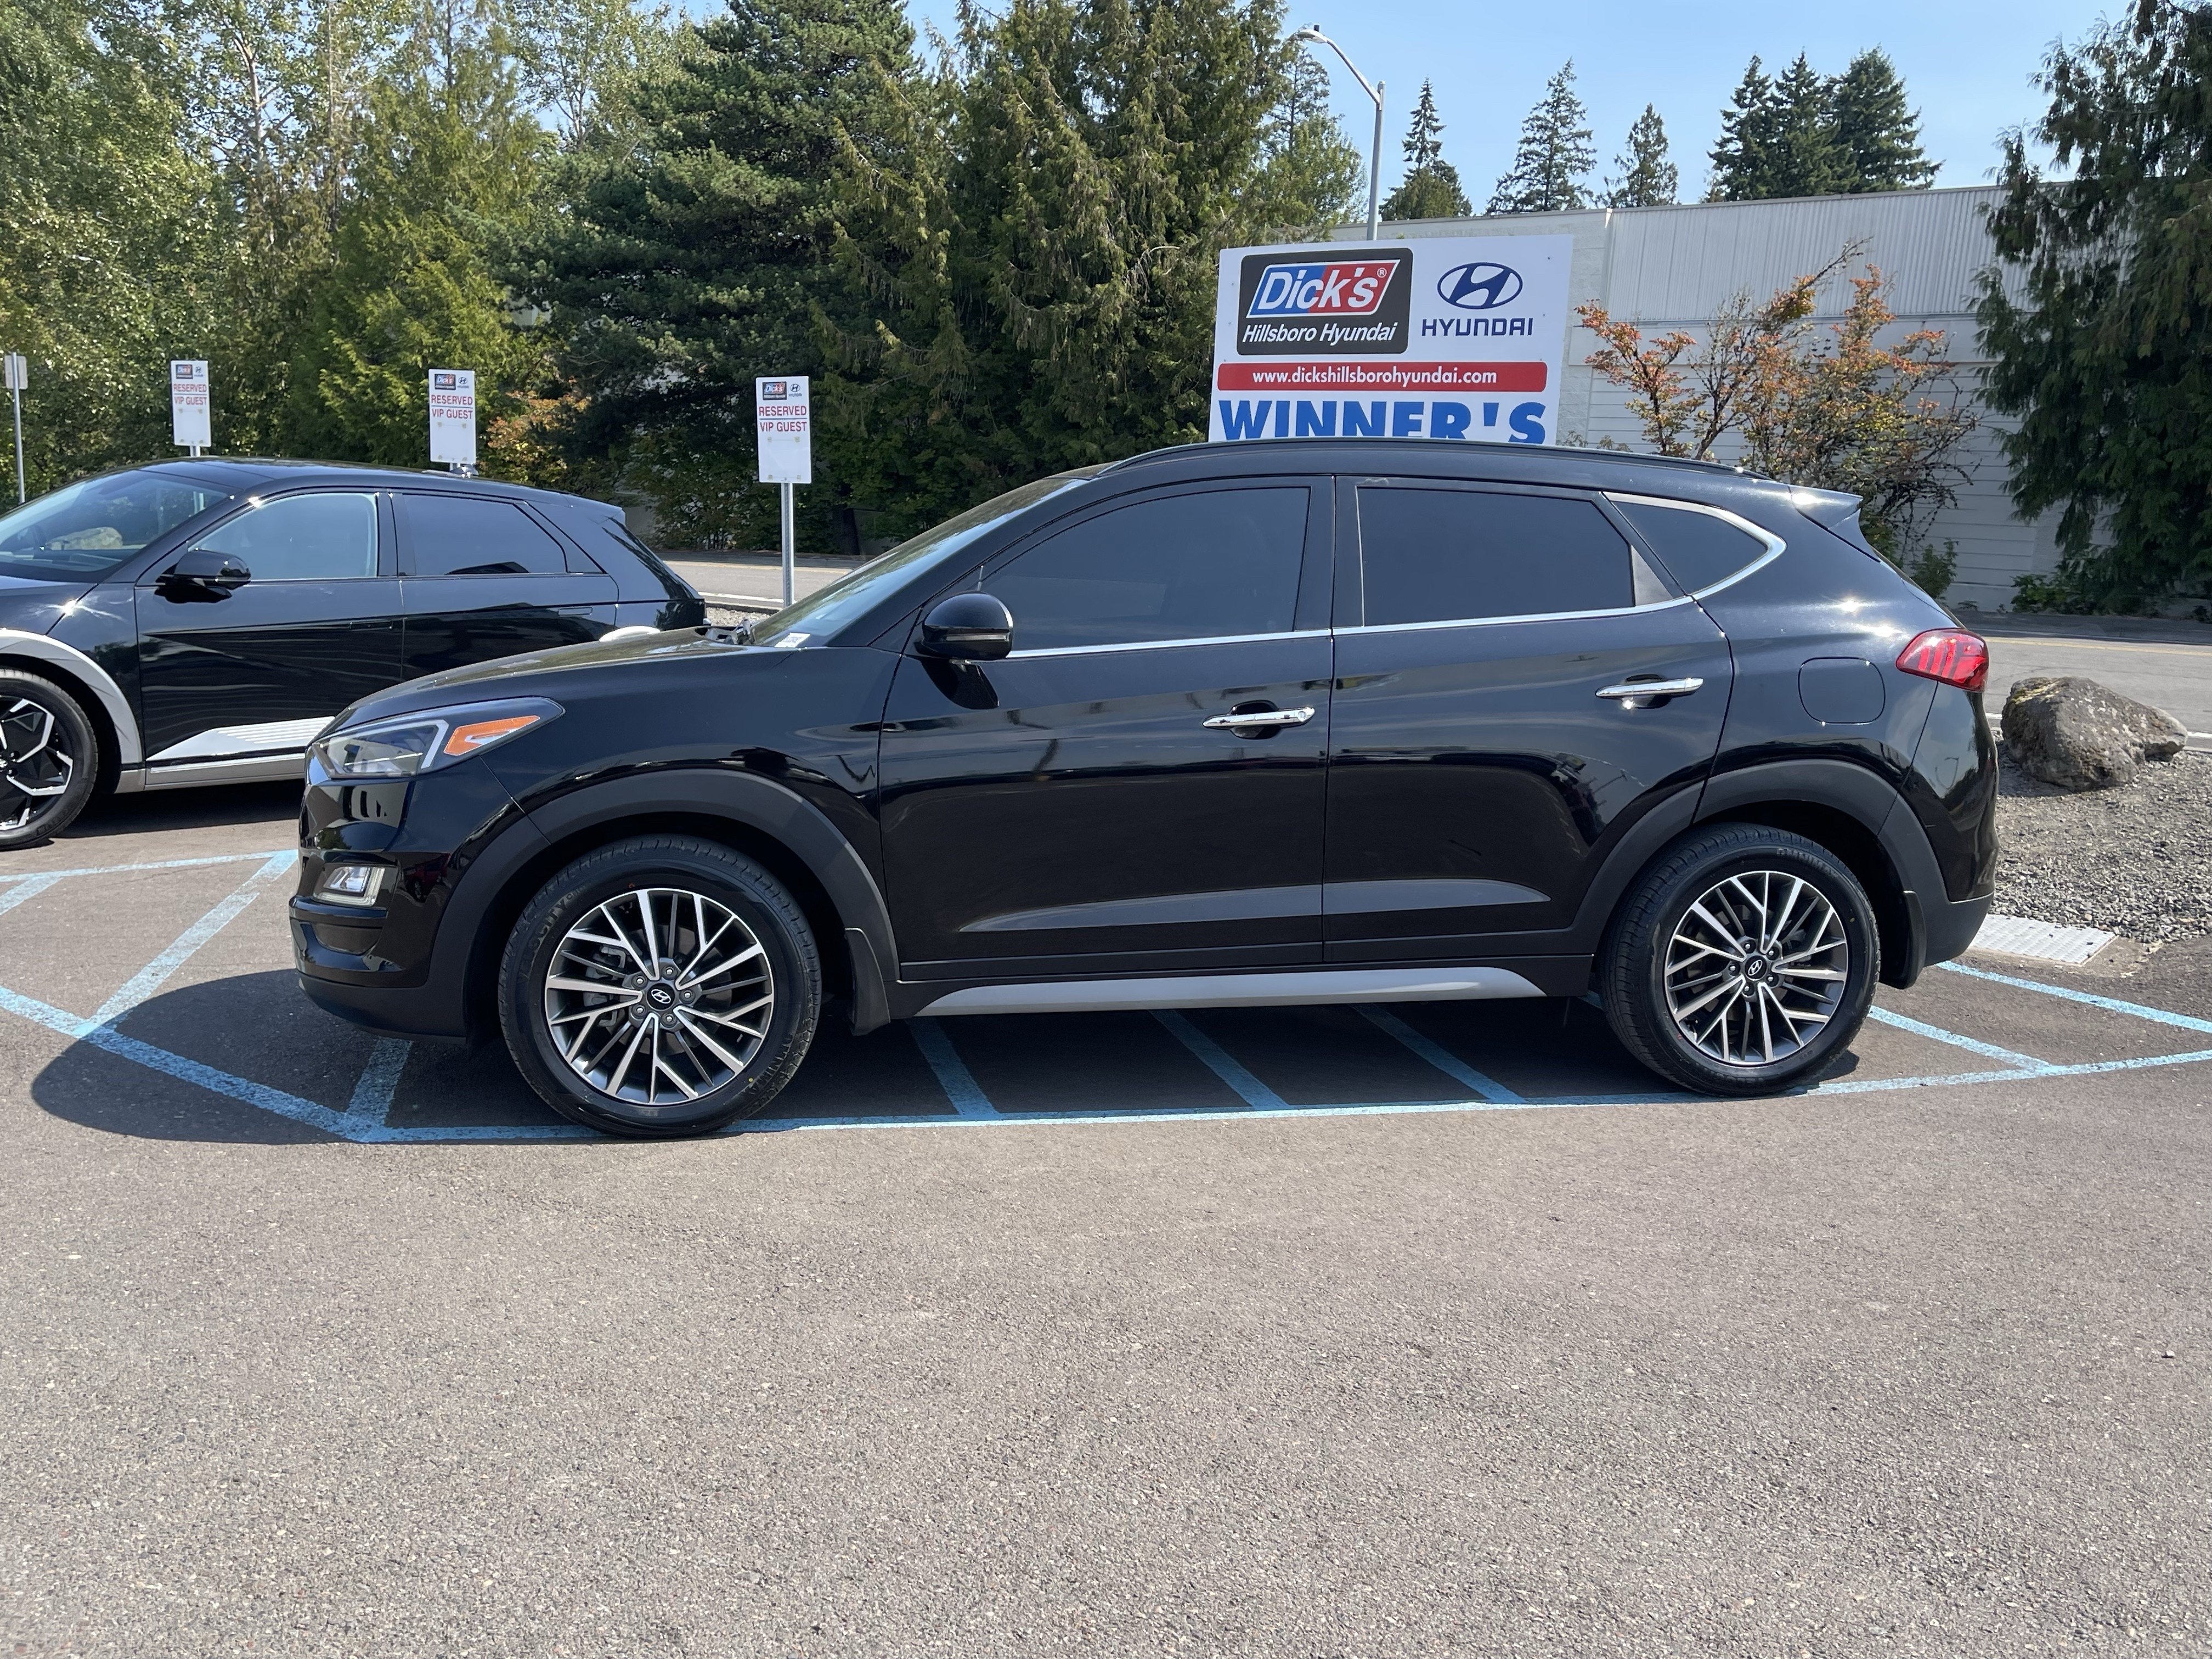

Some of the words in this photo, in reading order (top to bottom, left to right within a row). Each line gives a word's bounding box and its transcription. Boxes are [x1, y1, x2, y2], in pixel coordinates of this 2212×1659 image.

[1422, 318, 1533, 336] HYUNDAI
[1242, 324, 1317, 342] Hillsboro
[1319, 322, 1398, 346] Hyundai
[1252, 365, 1497, 388] www.dickshillsborohyundai.com
[173, 383, 207, 392] RESERVED
[174, 396, 184, 404] VIP
[185, 396, 207, 405] GUEST
[431, 394, 473, 405] RESERVED
[431, 408, 444, 418] VIP
[446, 409, 473, 419] GUEST
[759, 405, 807, 416] RESERVED
[759, 422, 774, 432] VIP
[776, 421, 808, 432] GUEST
[1218, 400, 1546, 444] WINNER'S
